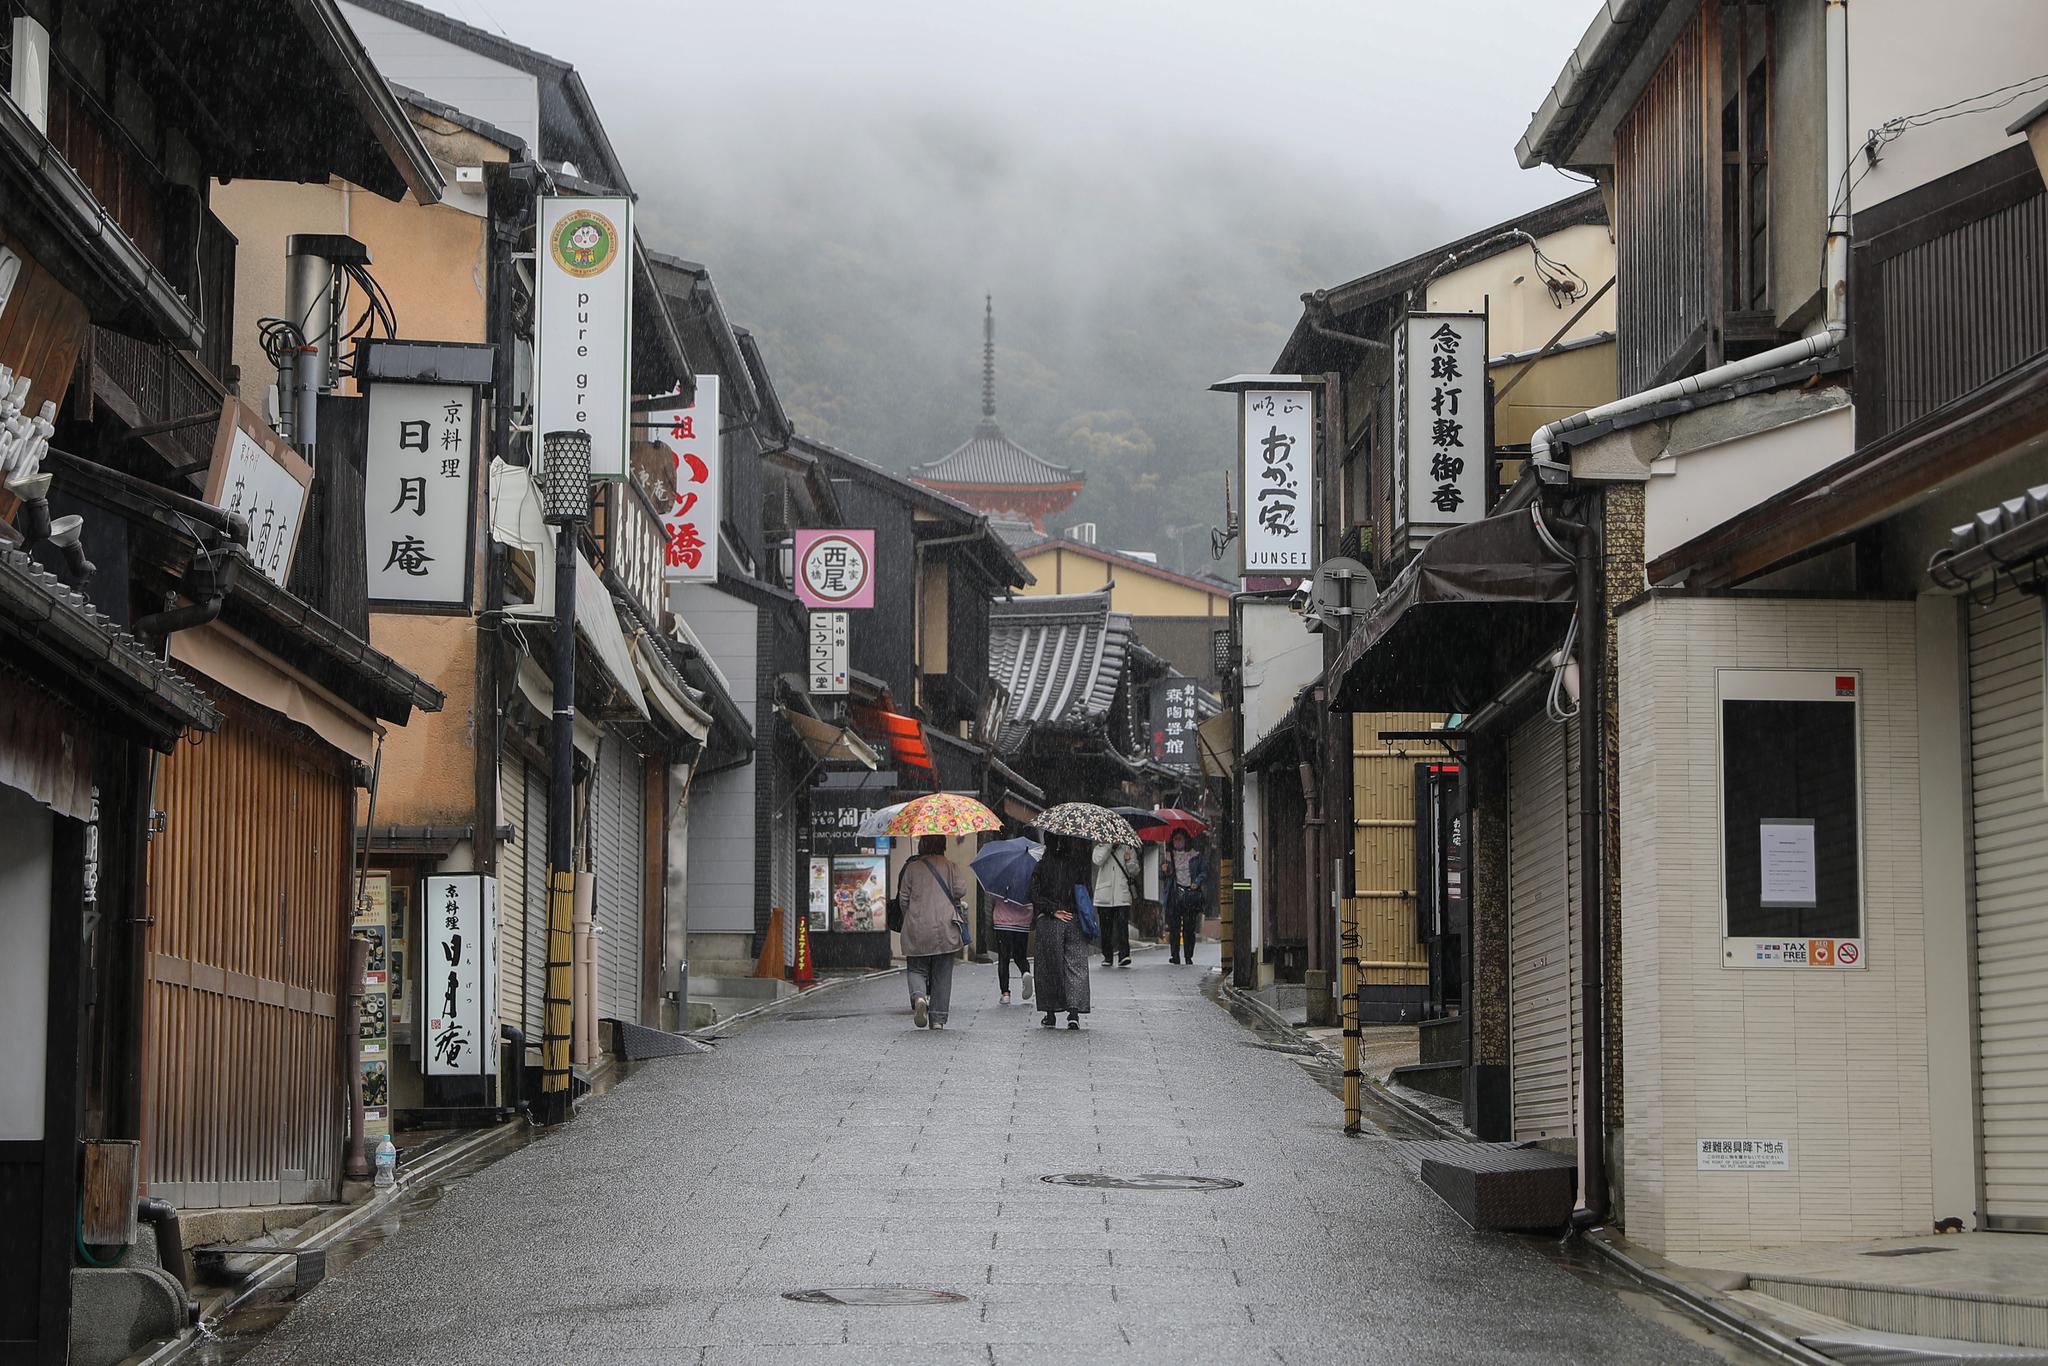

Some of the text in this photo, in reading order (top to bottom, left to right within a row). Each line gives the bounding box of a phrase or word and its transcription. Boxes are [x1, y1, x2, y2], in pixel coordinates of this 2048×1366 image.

[575, 292, 590, 434] pure gre
[439, 399, 463, 479] 京料理
[381, 419, 436, 577] 日月庵
[1257, 425, 1299, 538] おかべ家
[820, 546, 848, 592] 西尾
[848, 556, 860, 581] 本家
[1250, 551, 1308, 565] JUNSEI
[815, 615, 829, 689] こうらく堂
[444, 883, 461, 931] 京料理
[434, 933, 469, 1069] 日月庵
[1702, 1140, 1784, 1154] 避難器具降下地点
